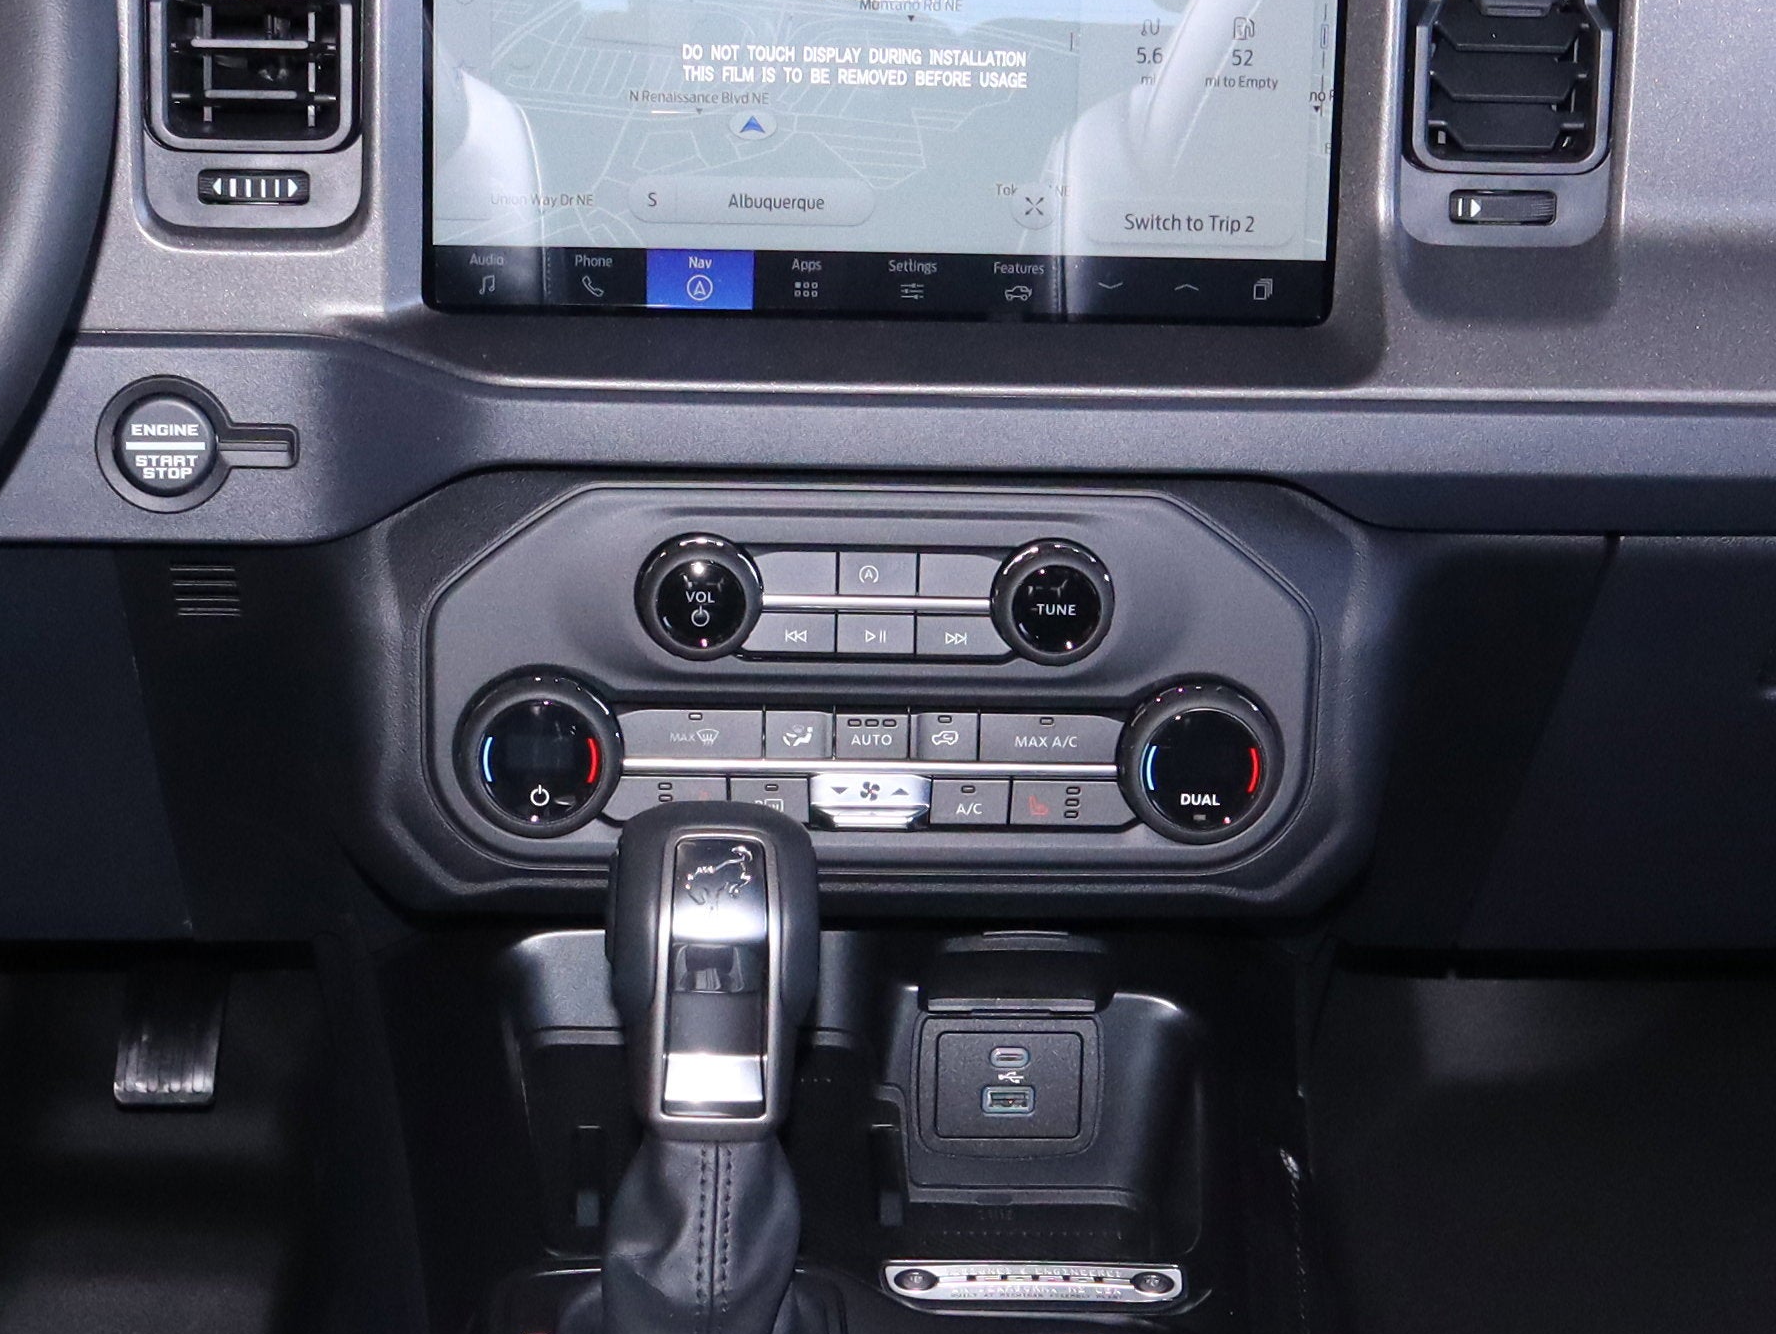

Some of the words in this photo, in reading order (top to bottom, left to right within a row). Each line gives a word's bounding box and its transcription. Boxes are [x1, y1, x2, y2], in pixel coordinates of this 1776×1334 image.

[944, 0, 963, 12] NE
[682, 44, 703, 60] DO
[711, 45, 740, 61] NOT
[747, 45, 795, 62] TOUCH
[803, 47, 862, 64] DISPLAY
[869, 48, 922, 65] DURING
[929, 49, 1027, 67] INSTALLATION
[1136, 47, 1163, 65] 5.6
[1231, 50, 1254, 67] 52
[682, 65, 714, 82] THIS
[722, 66, 754, 82] FILM
[762, 67, 776, 83] IS
[783, 67, 803, 84] TO
[811, 68, 830, 84] BE
[838, 69, 907, 86] REMOVED
[915, 70, 972, 87] BEFORE
[979, 71, 1027, 88] USAGE
[1205, 76, 1220, 87] mi
[1224, 76, 1236, 88] to
[1238, 76, 1279, 90] Empty
[629, 90, 640, 103] N
[642, 91, 719, 105] Renaissance
[722, 92, 750, 105] Blvd
[752, 93, 769, 105] NE
[491, 194, 527, 207] Union
[530, 194, 558, 208] Way
[561, 194, 575, 206] Dr
[577, 195, 593, 206] NE
[648, 192, 658, 207] S
[728, 195, 825, 211] Albuquerque
[1124, 213, 1181, 232] Switch
[1186, 215, 1203, 233] to
[1209, 215, 1241, 234] Trip
[1245, 216, 1255, 233] 2
[469, 253, 504, 266] Audio
[575, 254, 613, 268] Phone
[688, 256, 712, 269] Nav
[792, 259, 822, 273] Apps
[888, 259, 937, 275] Settings
[993, 262, 1045, 275] Features
[131, 423, 199, 436] ENGINE
[135, 455, 198, 467] START
[143, 467, 192, 479] STOP
[685, 591, 715, 605] VOL
[1036, 603, 1077, 616] TUNE
[669, 733, 696, 743] MAX
[850, 734, 893, 747] AUTO
[1014, 735, 1047, 748] MAX
[1051, 734, 1078, 749] A/C
[1179, 792, 1220, 807] DUAL
[956, 802, 983, 817] A/C
